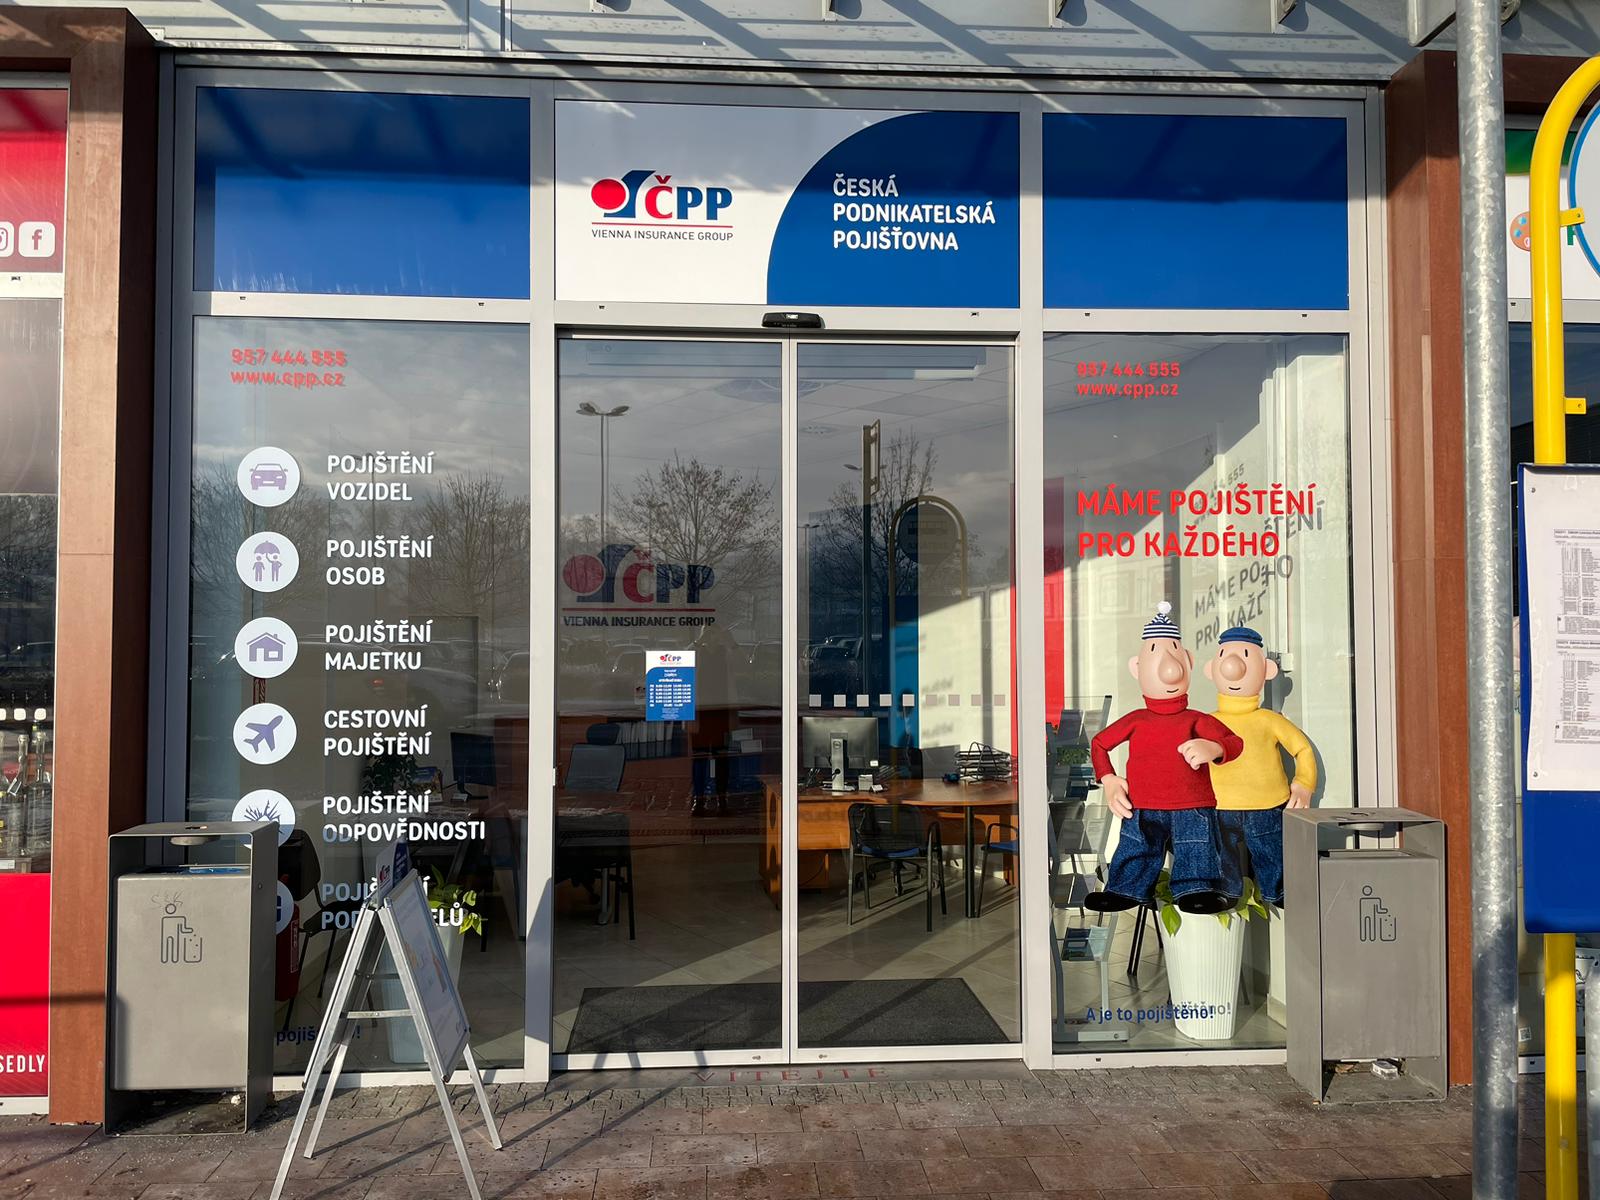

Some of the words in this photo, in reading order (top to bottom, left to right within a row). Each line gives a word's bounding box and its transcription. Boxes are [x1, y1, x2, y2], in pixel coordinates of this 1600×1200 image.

[644, 174, 733, 220] ČPP
[833, 173, 899, 197] ČESKÁ
[833, 201, 996, 224] PODNIKATELSKÁ
[591, 229, 631, 239] VIENNA
[634, 230, 695, 240] INSURANCE
[698, 231, 734, 241] GROUP
[833, 226, 959, 250] POJIŠŤOVNA
[231, 348, 266, 365] 957
[271, 349, 307, 365] 444
[311, 349, 347, 366] 555
[1077, 361, 1107, 377] 957
[1112, 362, 1145, 377] 444
[1149, 362, 1181, 377] 555
[231, 371, 346, 389] www.cpp.cz
[1077, 383, 1180, 399] www.cpp.cz
[327, 450, 435, 475] POJIŠTĚNÍ
[327, 482, 412, 501] VOZIDEL
[1077, 483, 1161, 516] MÁME
[1169, 483, 1316, 516] POJIŠTĚNÍ
[326, 534, 433, 558] POJIŠTĚNÍ
[1078, 531, 1135, 558] PRO
[1145, 525, 1280, 557] KAŽDÉHO
[326, 567, 386, 586] OSOB
[622, 547, 715, 603] ČPP
[325, 619, 433, 644] POJIŠTĚNÍ
[563, 616, 609, 627] VIENNA
[611, 617, 676, 627] INSURANCE
[678, 617, 716, 627] GROUP
[325, 651, 422, 670] MAJETKU
[323, 704, 428, 729] CESTOVNÍ
[323, 731, 432, 757] POJIŠTĚNÍ
[322, 789, 431, 815] POJIŠTĚNÍ
[322, 818, 485, 843] ODPOVĚDNOSTI
[1086, 1007, 1096, 1021] A
[1099, 1006, 1113, 1024] je
[1117, 1007, 1132, 1021] to
